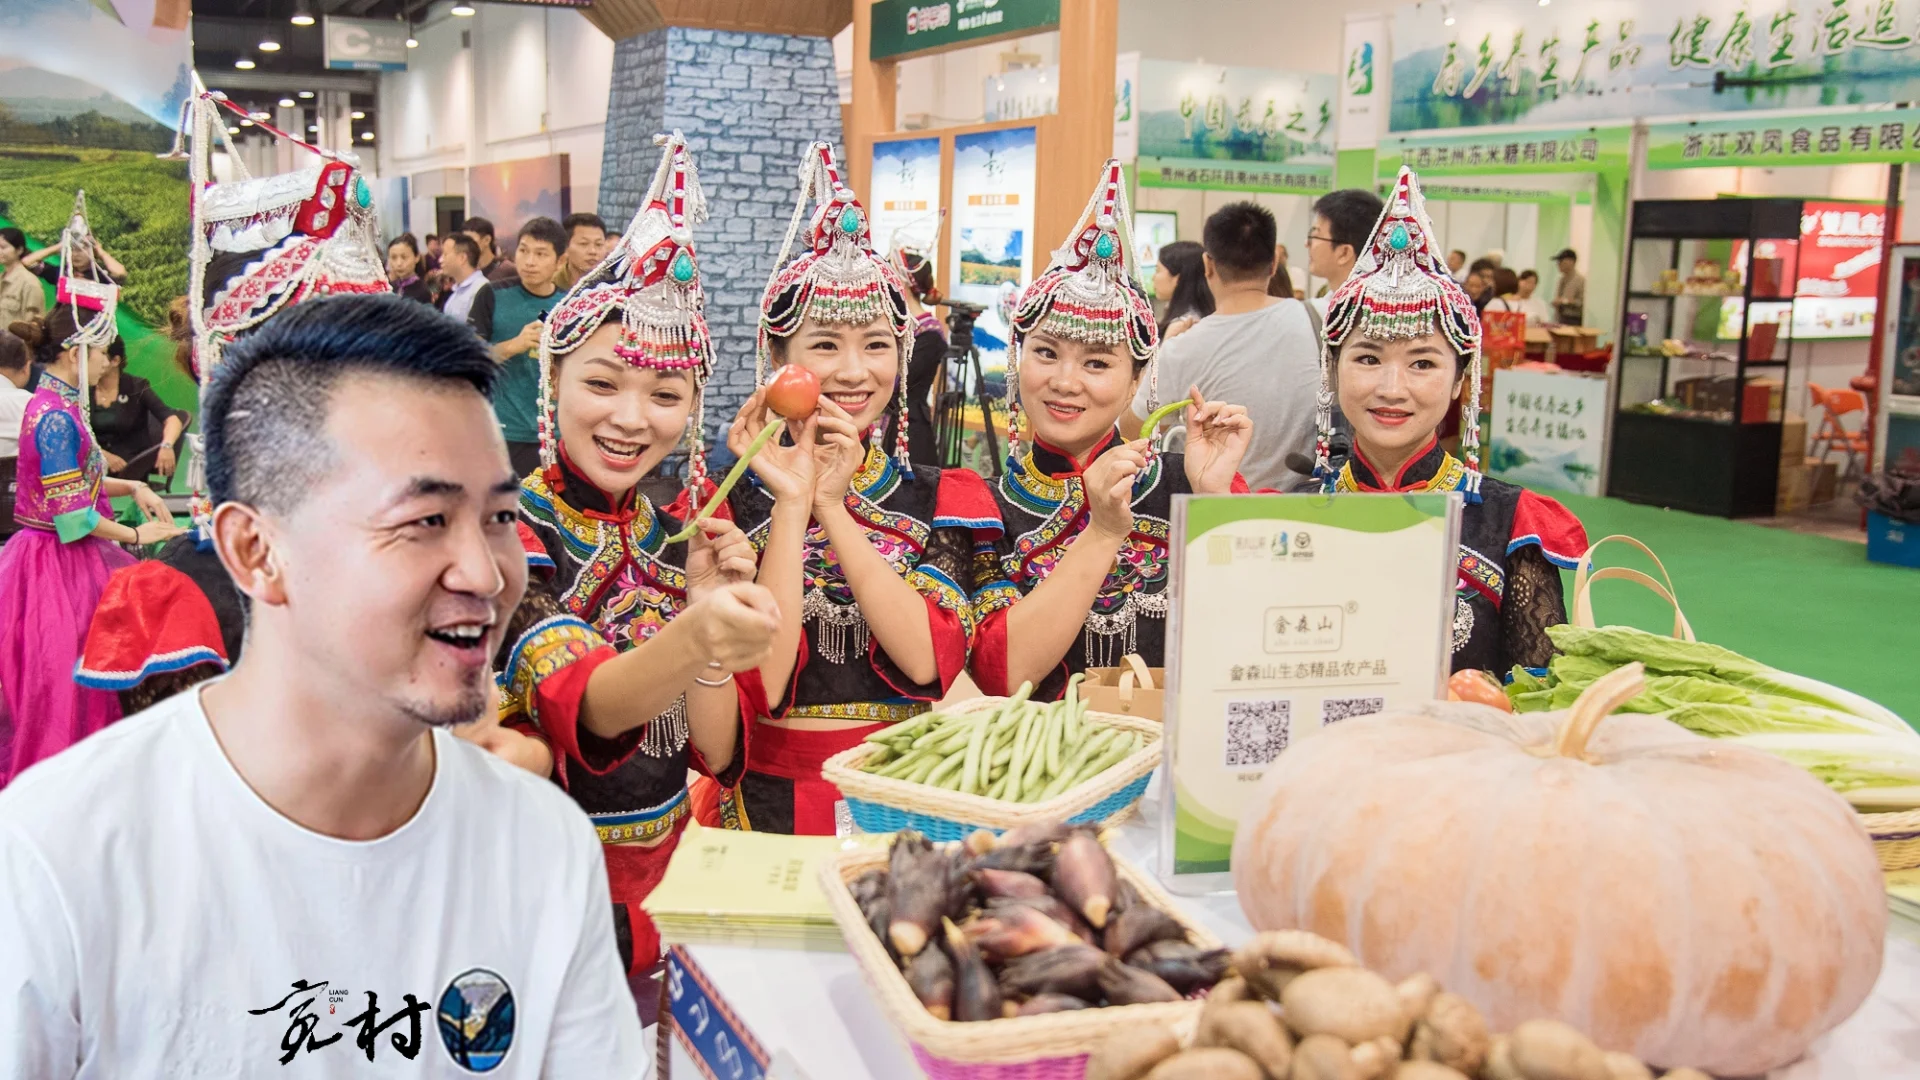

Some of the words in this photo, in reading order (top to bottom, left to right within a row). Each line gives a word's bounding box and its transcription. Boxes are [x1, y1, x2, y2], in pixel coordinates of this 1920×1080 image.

[332, 24, 371, 57] C
[1667, 0, 1920, 71] 健康生活追
